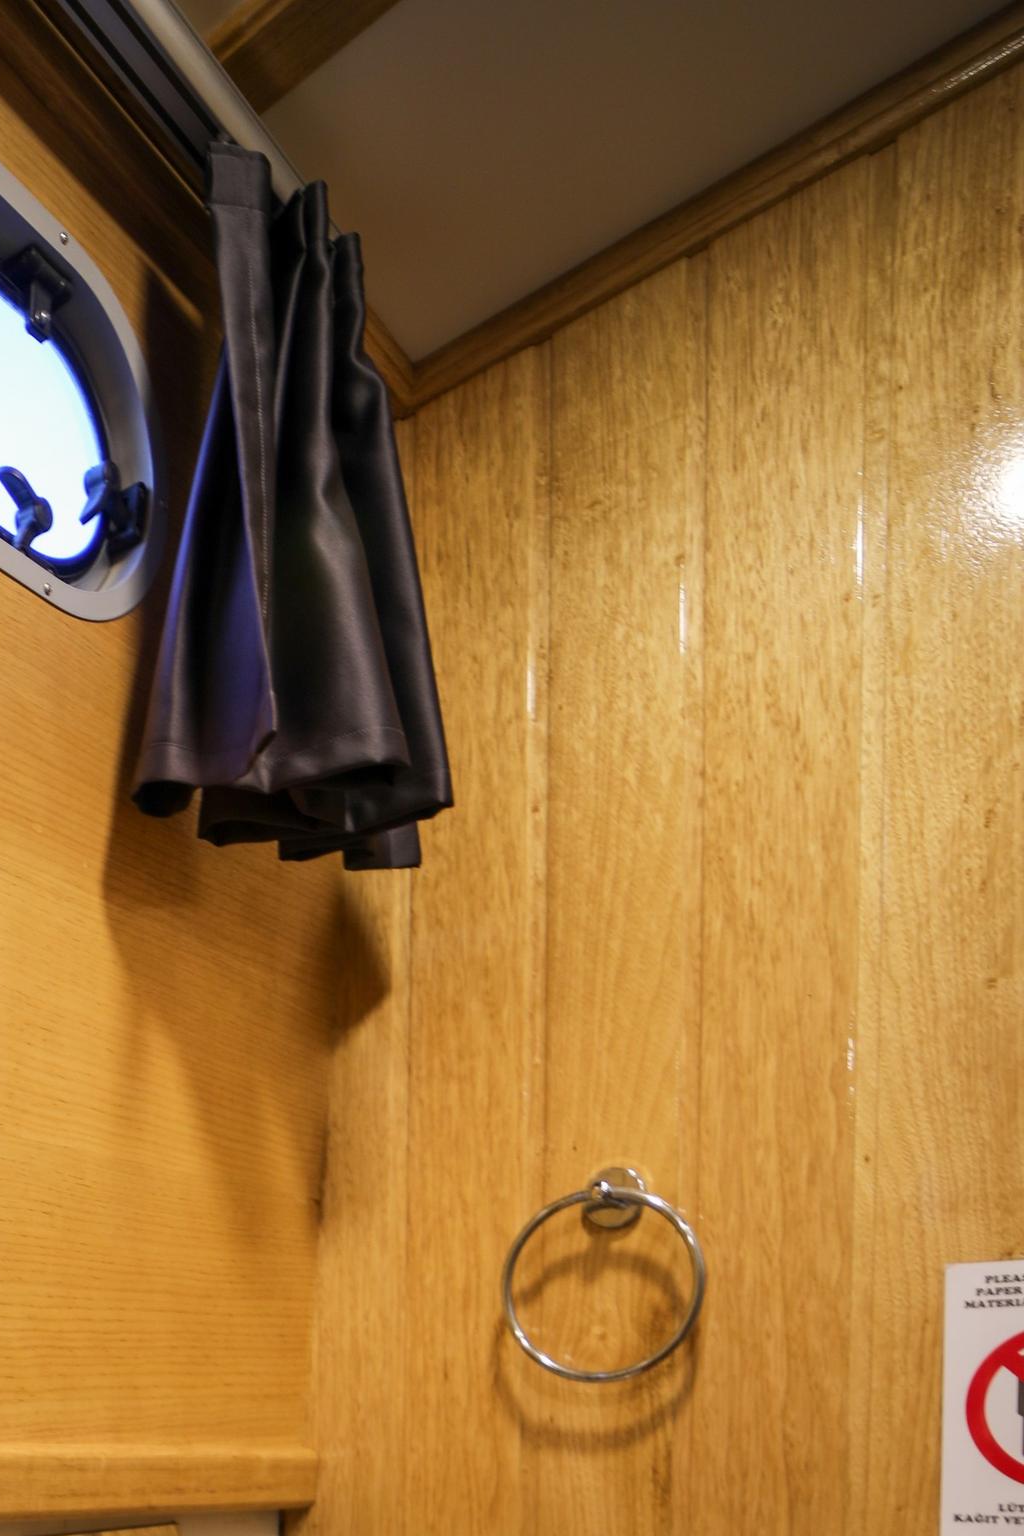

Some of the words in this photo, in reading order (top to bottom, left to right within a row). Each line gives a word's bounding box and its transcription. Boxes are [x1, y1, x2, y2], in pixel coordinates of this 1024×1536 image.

[984, 1274, 1024, 1284] PLEA
[976, 1286, 1023, 1296] PAPER
[964, 1298, 1024, 1309] MATERI
